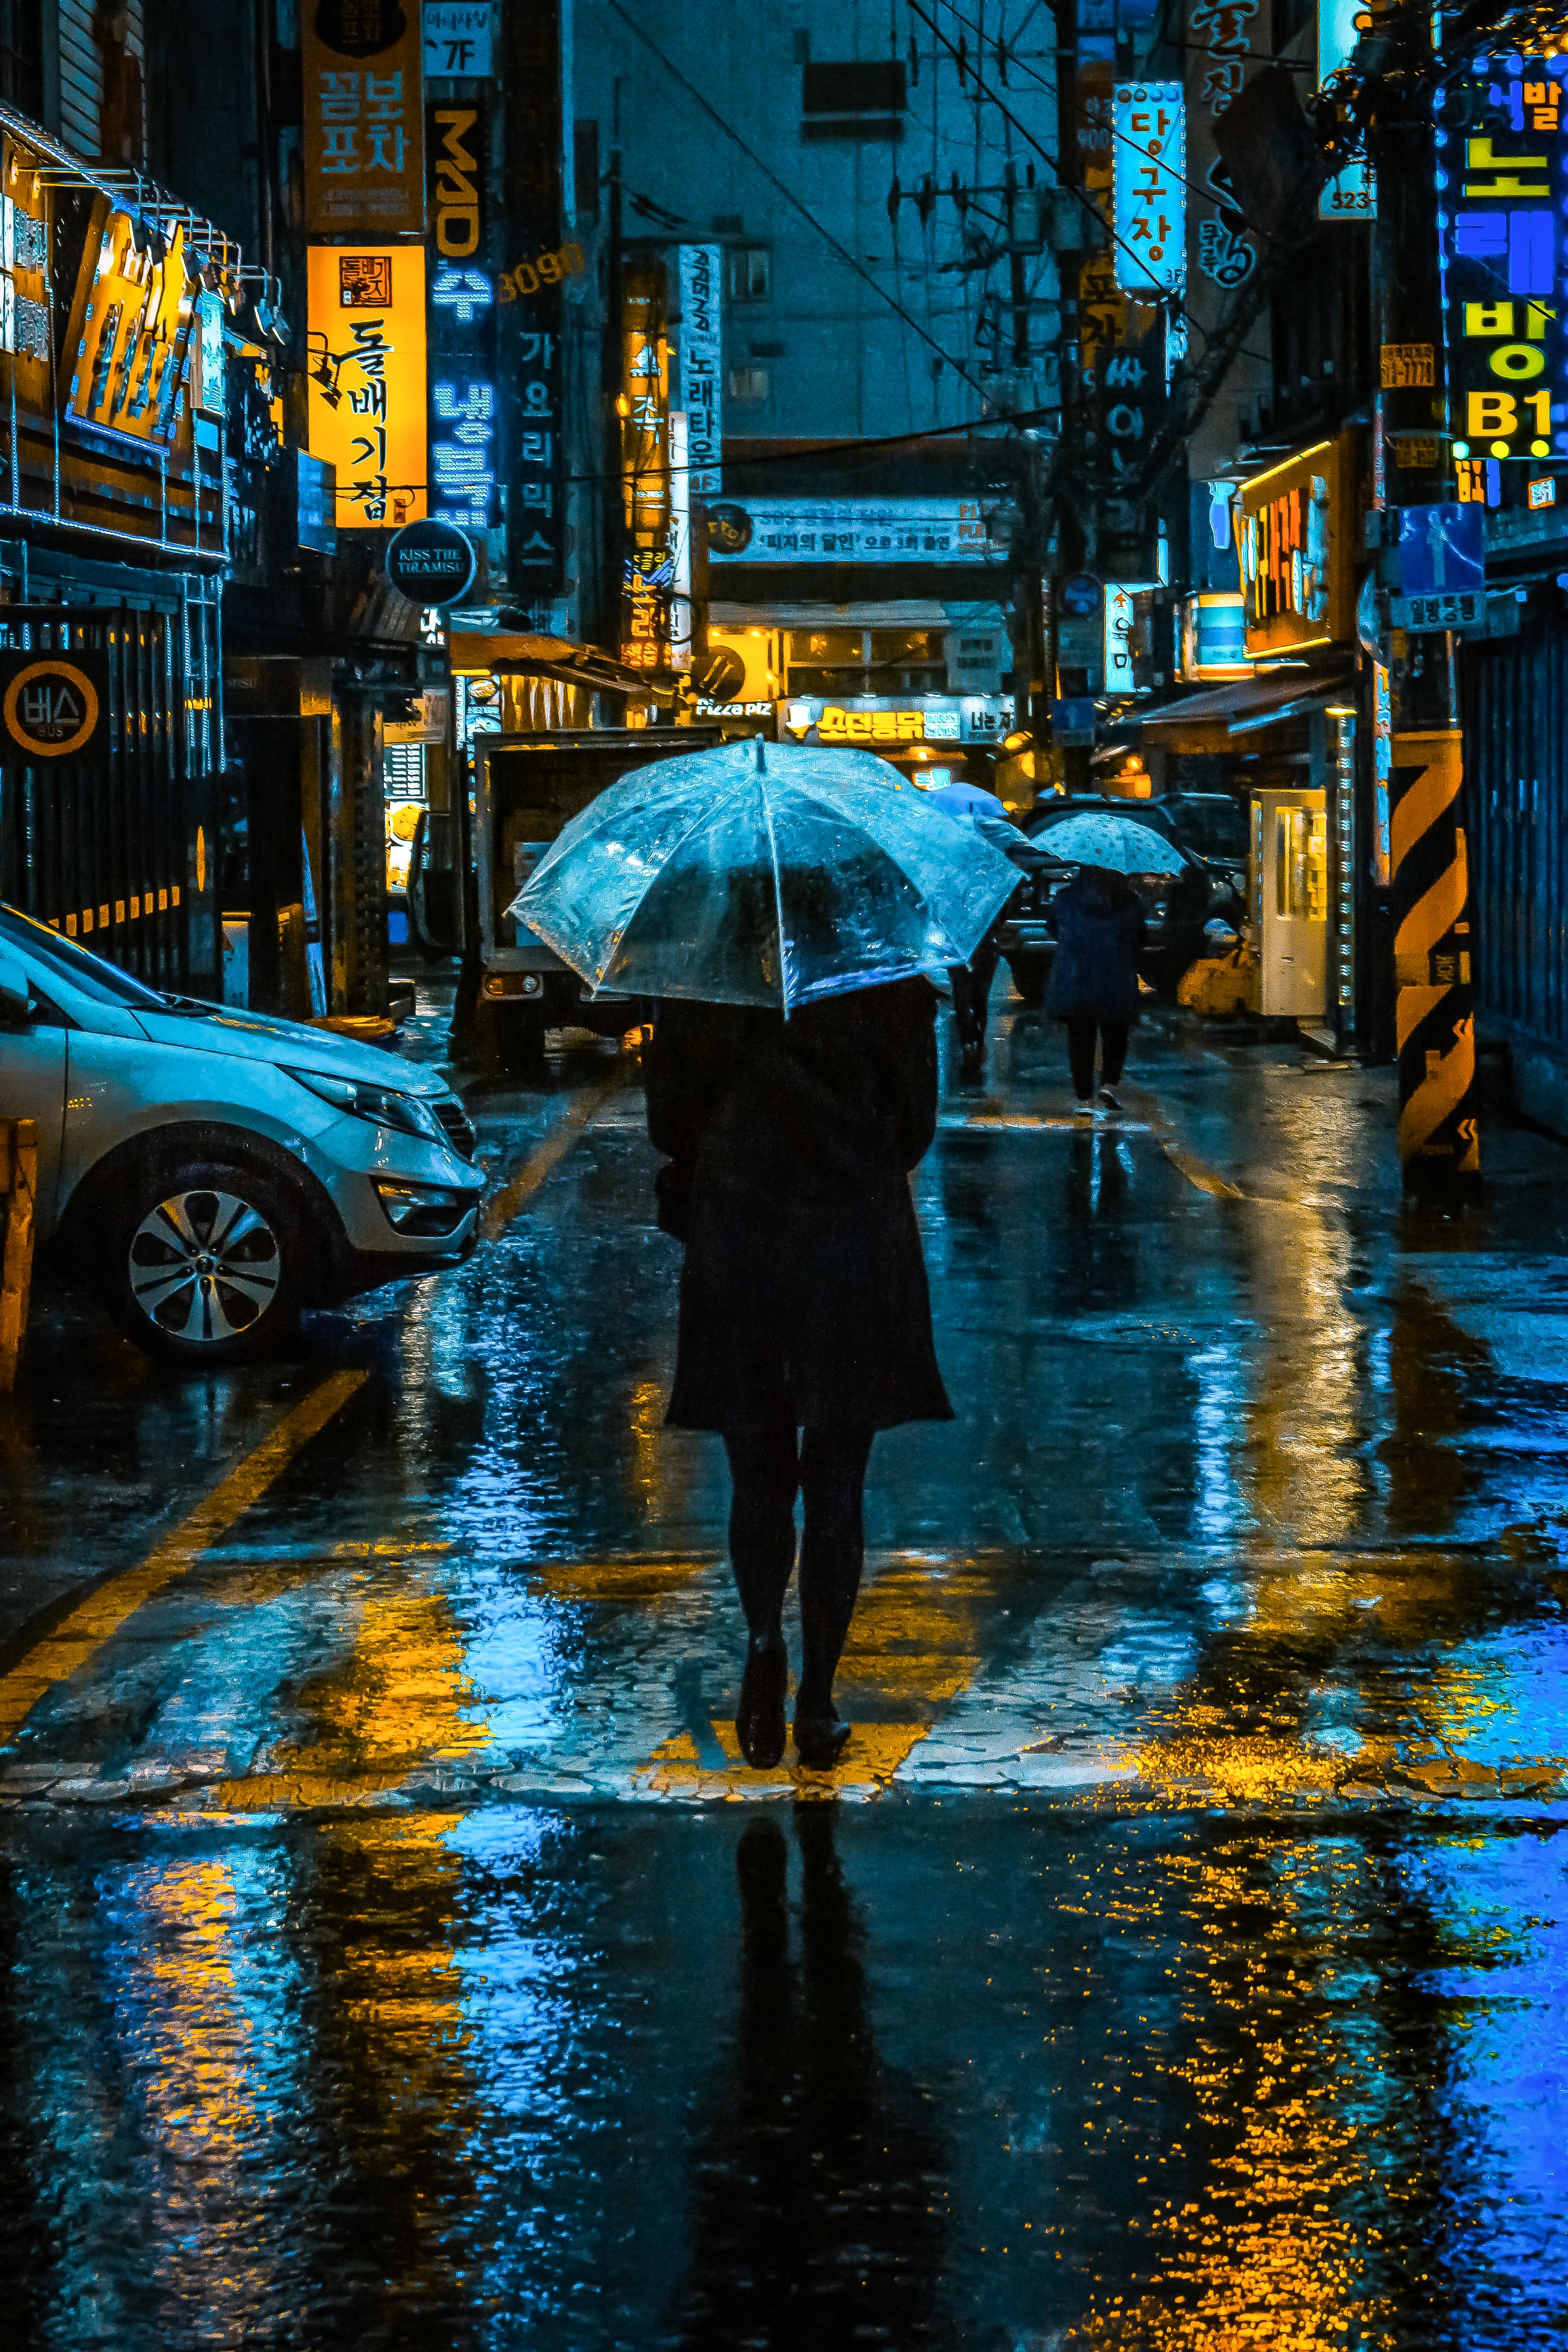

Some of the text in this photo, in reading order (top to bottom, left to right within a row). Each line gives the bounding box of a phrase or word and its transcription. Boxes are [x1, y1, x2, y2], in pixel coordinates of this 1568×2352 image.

[441, 40, 475, 70] 7F
[320, 123, 411, 172] 포차
[1131, 108, 1172, 262] 당구장
[347, 318, 395, 521] 돌배기집
[1467, 388, 1552, 437] B1
[399, 549, 461, 560] KISS THE
